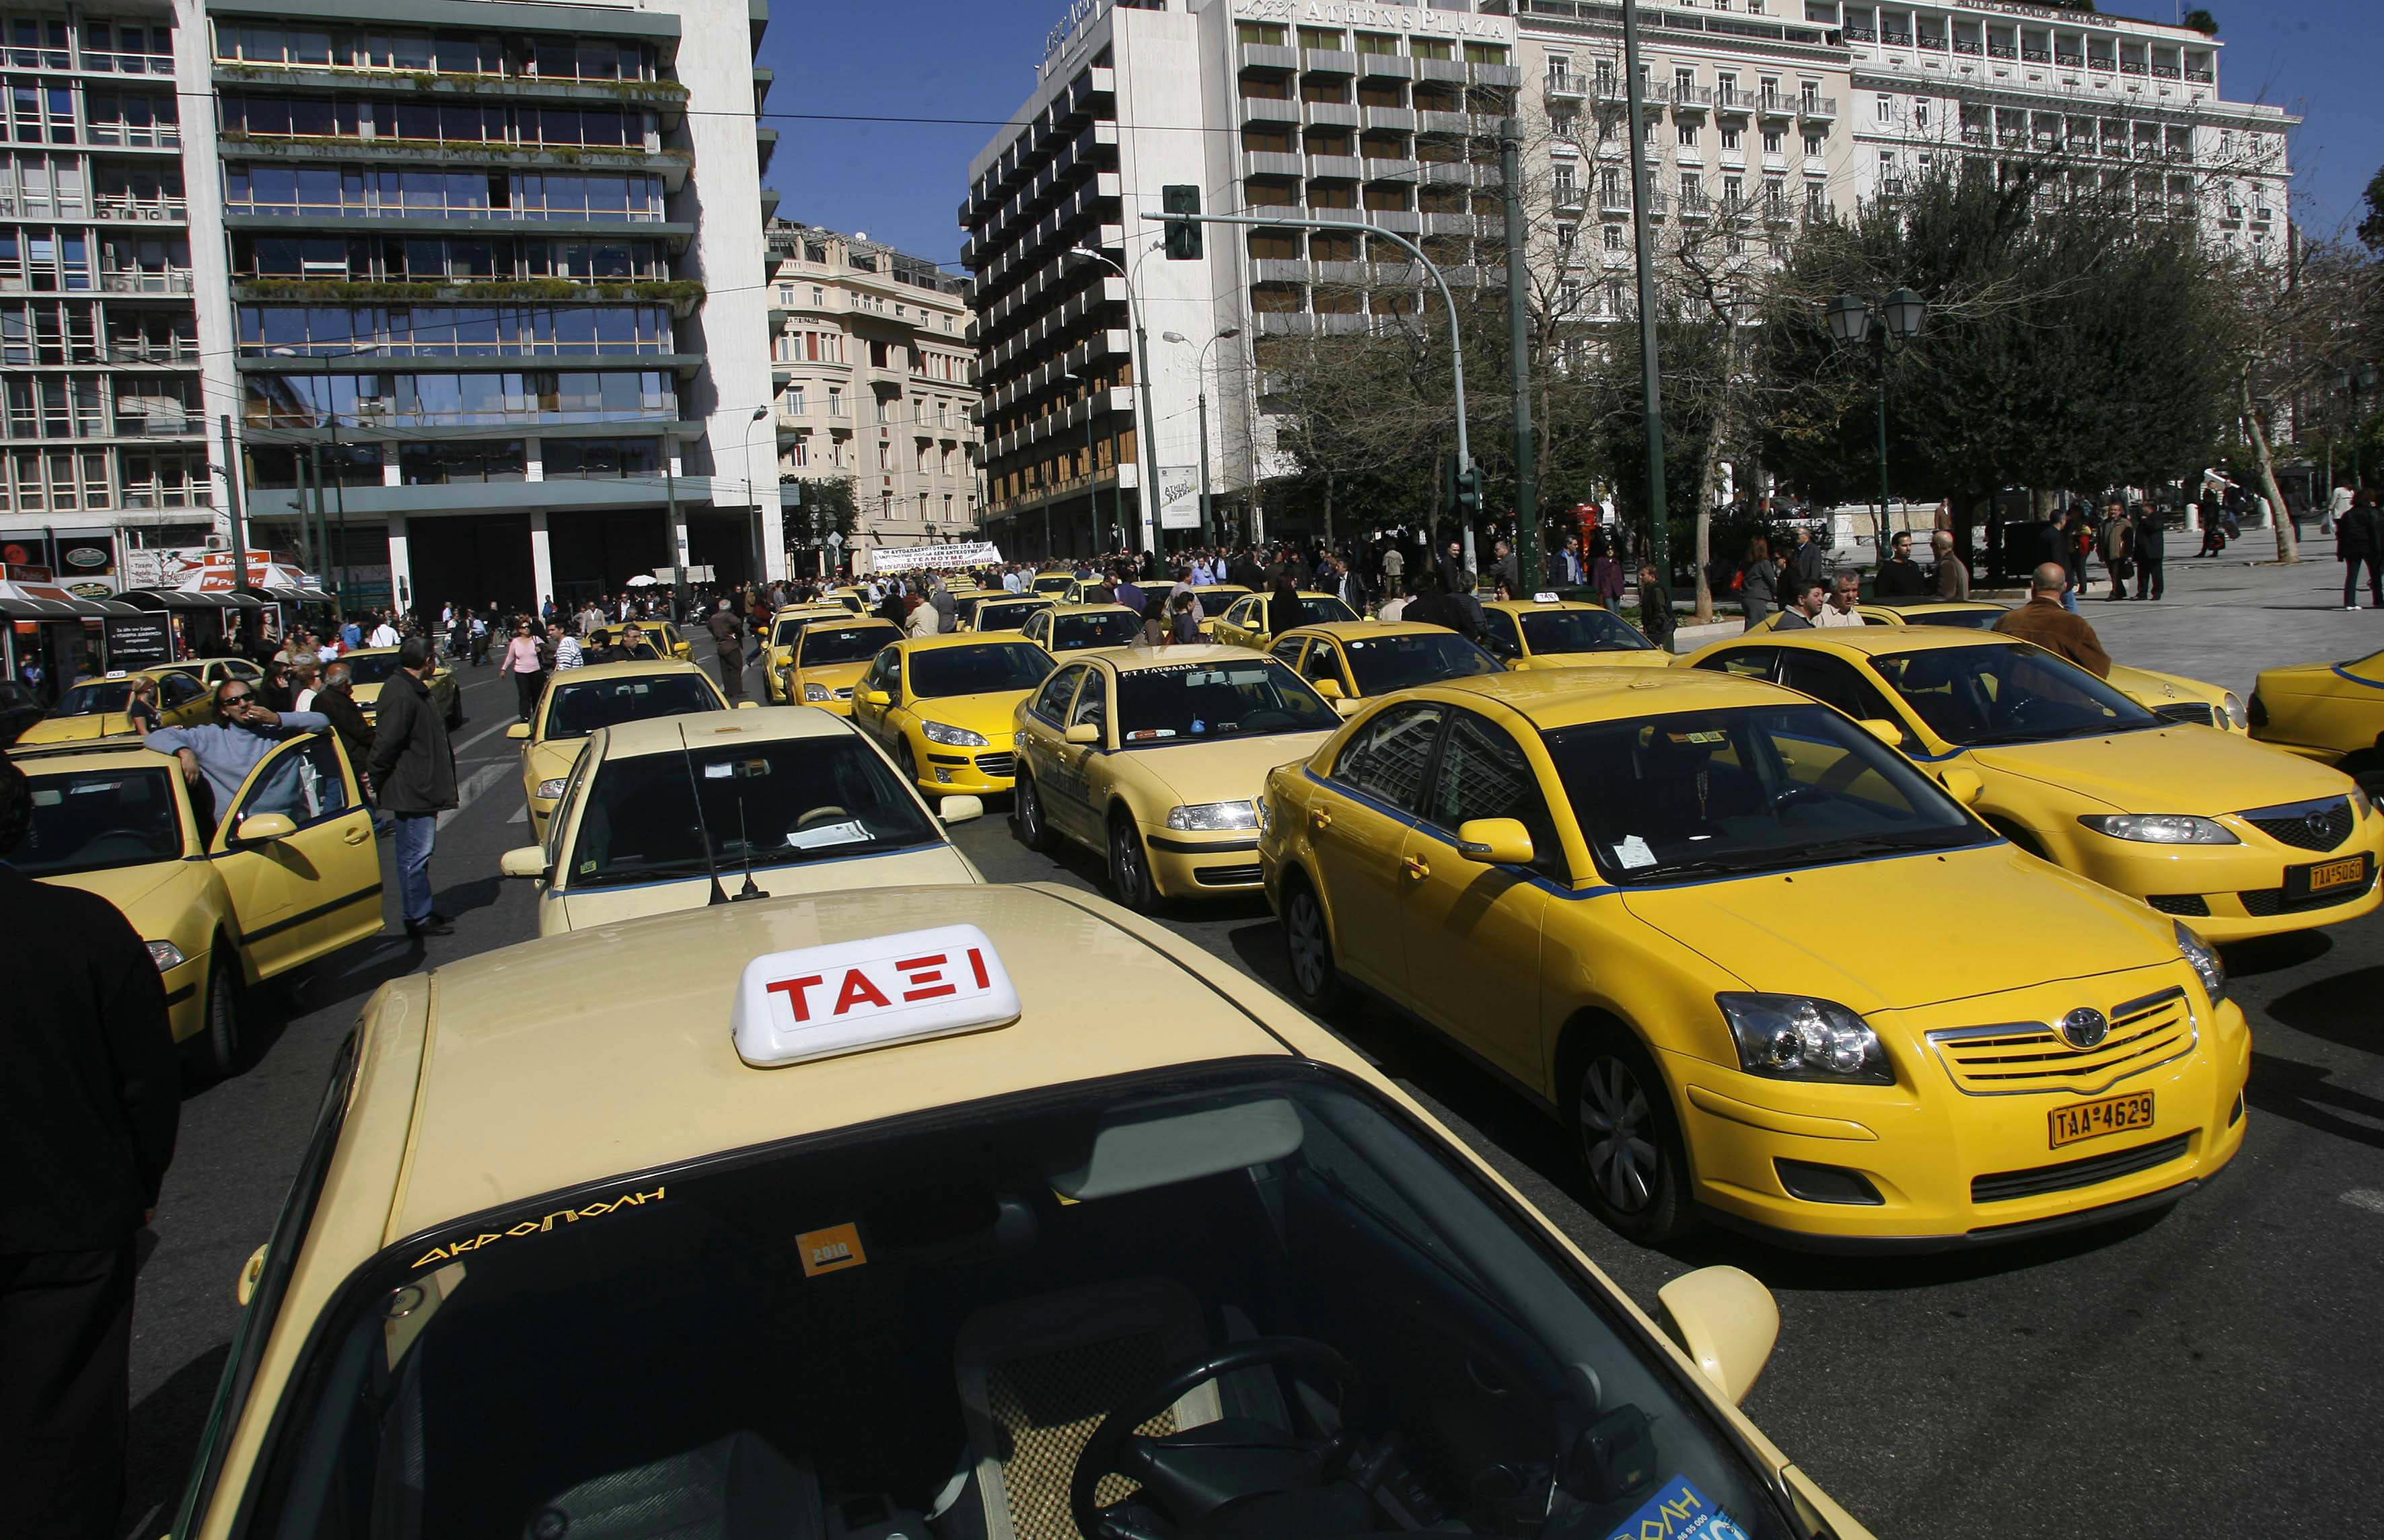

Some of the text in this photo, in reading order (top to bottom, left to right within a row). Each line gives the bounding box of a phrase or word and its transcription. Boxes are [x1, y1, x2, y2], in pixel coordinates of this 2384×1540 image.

[1305, 1, 1412, 28] ATHENS
[1419, 9, 1505, 38] PLAZA
[766, 948, 990, 1022] ΤΑΞΙ
[411, 1187, 665, 1269] ΑΚΡΟΠΟΛΗ
[1694, 1514, 1708, 1528] 000
